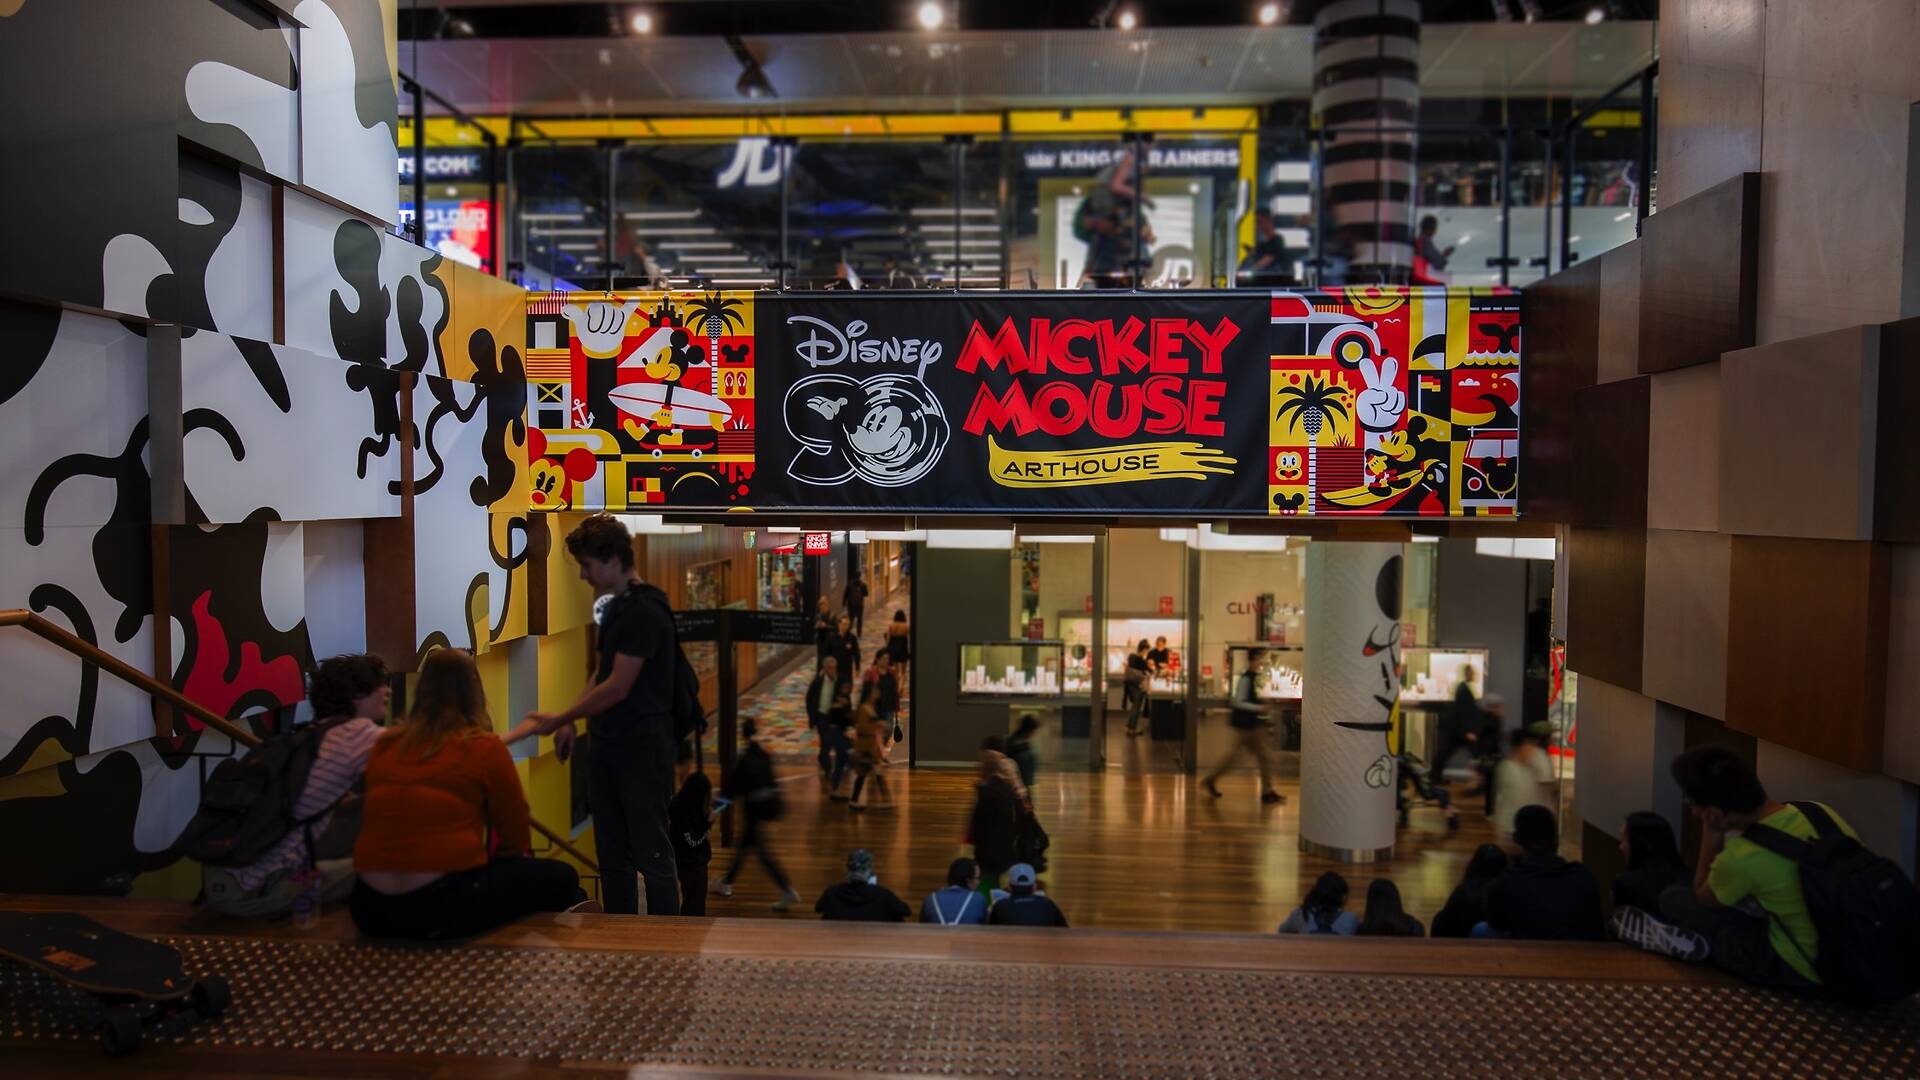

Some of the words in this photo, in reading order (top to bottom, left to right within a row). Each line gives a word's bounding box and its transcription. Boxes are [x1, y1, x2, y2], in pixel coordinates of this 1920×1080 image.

[717, 138, 793, 189] JD
[1146, 149, 1240, 167] RAINERS
[955, 315, 1241, 376] MICKEY
[962, 375, 1227, 439] MOUSE
[1003, 454, 1160, 477] ARTHOUSE
